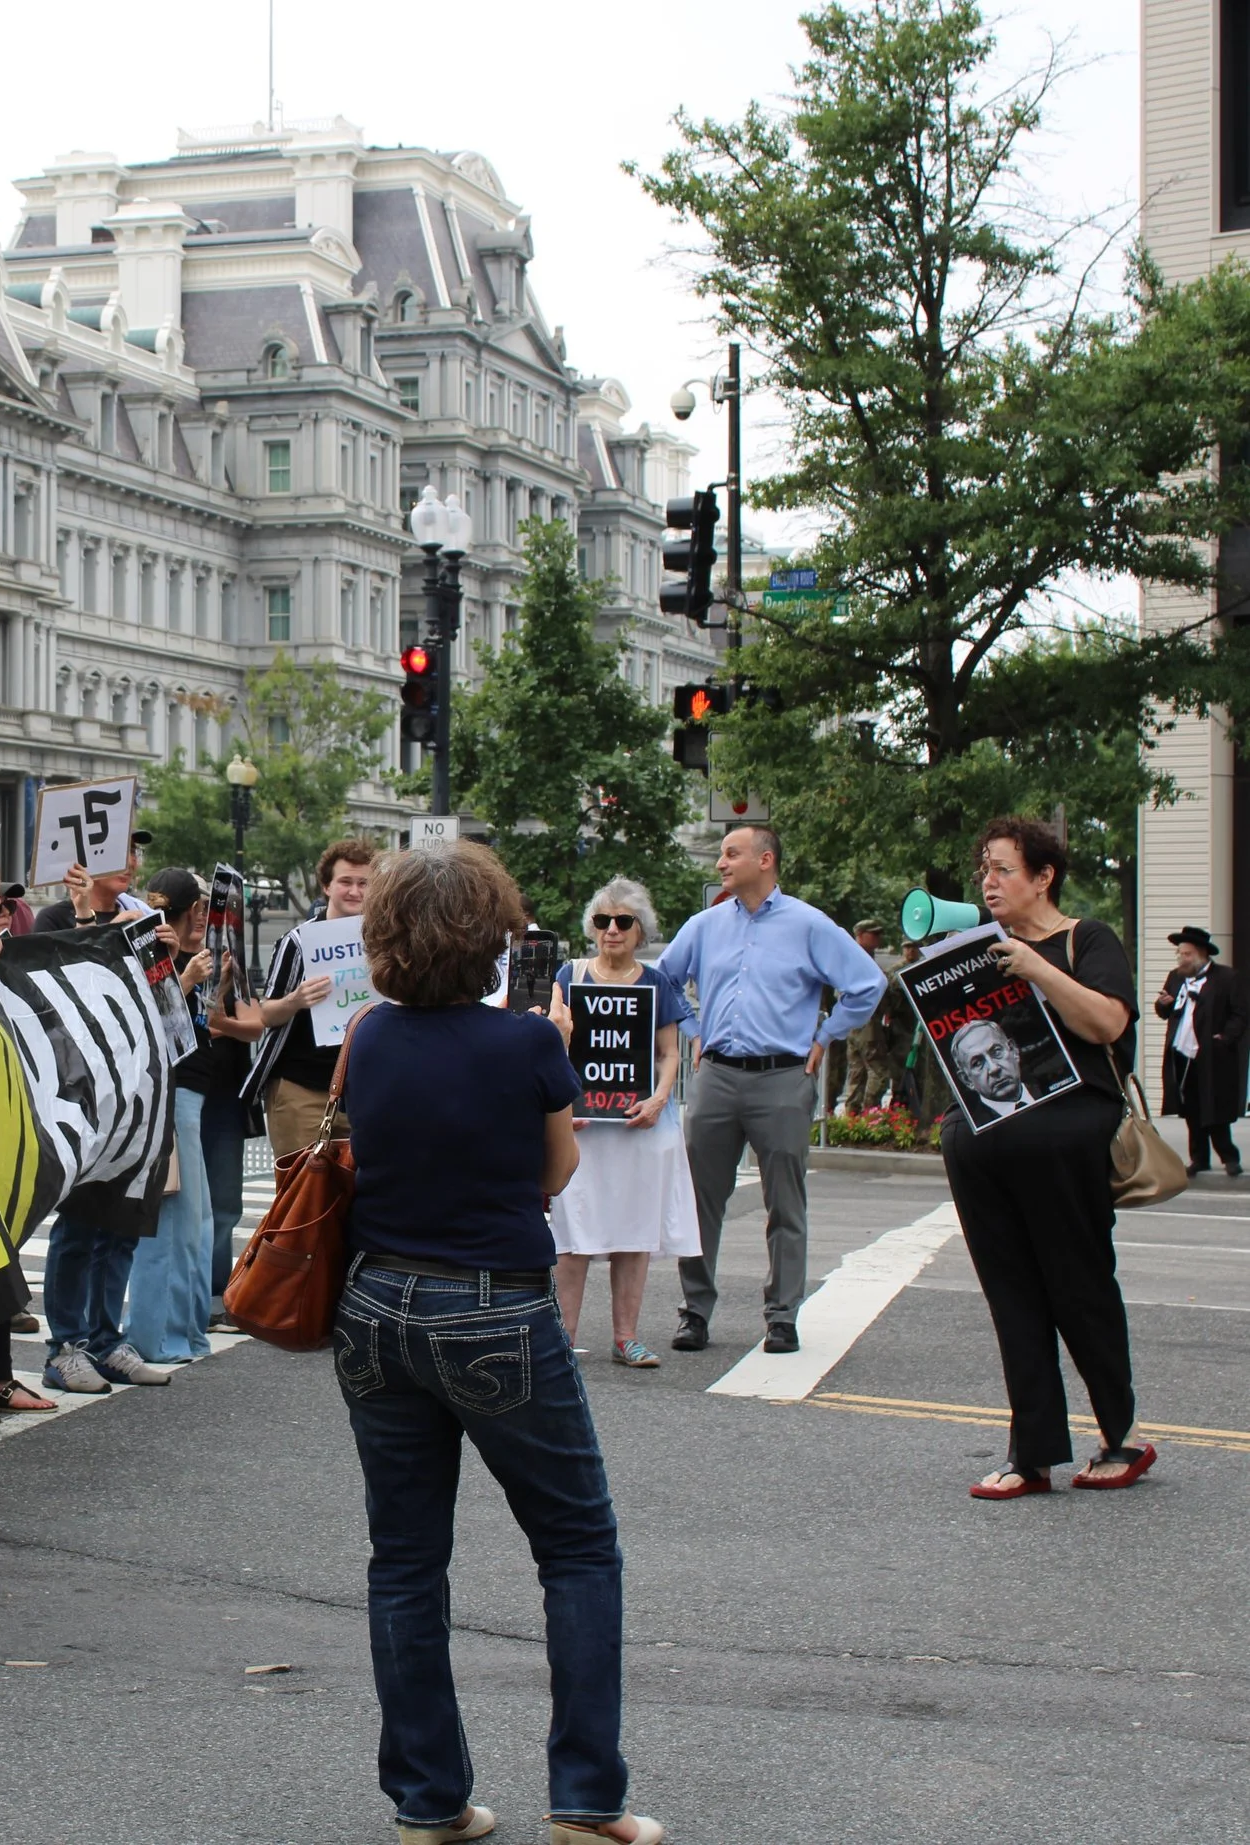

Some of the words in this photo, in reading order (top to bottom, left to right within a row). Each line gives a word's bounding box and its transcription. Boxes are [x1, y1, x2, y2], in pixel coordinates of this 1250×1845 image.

[424, 823, 444, 835] NO
[310, 942, 362, 963] JUSTI
[914, 951, 999, 997] NETANYAHU
[336, 989, 370, 1008] عدل
[584, 996, 638, 1016] VOTE
[928, 979, 1032, 1041] DISASTER
[590, 1030, 630, 1049] HIM
[585, 1063, 635, 1082] OUT!
[584, 1091, 638, 1111] 10/27
